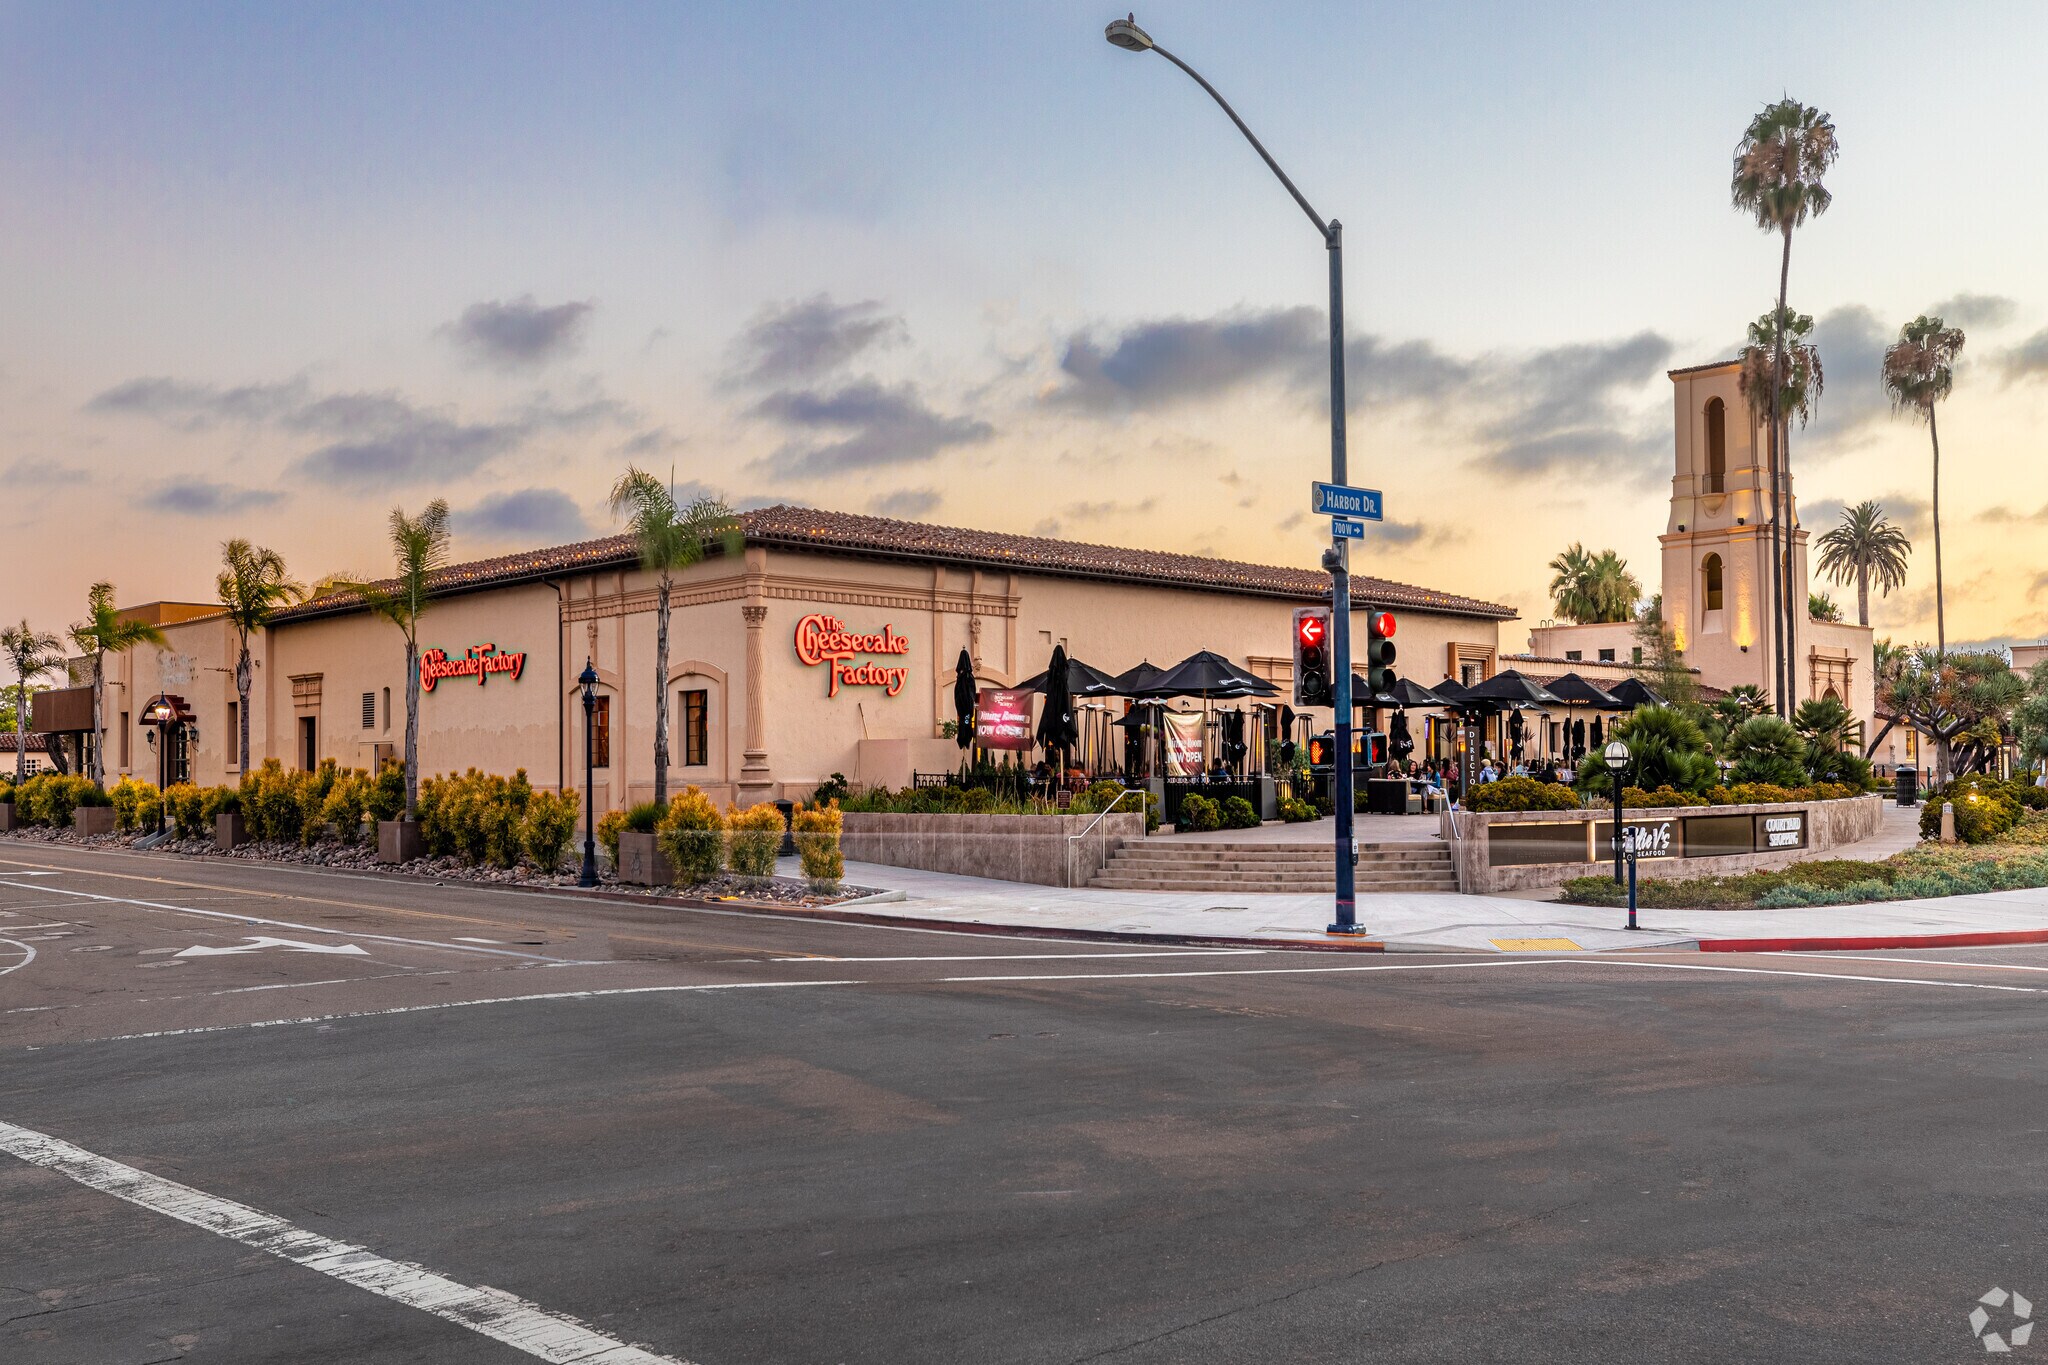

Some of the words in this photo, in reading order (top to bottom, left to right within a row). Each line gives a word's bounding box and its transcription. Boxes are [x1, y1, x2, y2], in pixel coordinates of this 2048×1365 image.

[794, 614, 909, 666] Cheesecake
[824, 615, 845, 632] The
[420, 648, 479, 692] Cheesecake
[472, 643, 526, 686] Factory
[819, 650, 910, 698] Factory
[1186, 751, 1202, 763] OPEN
